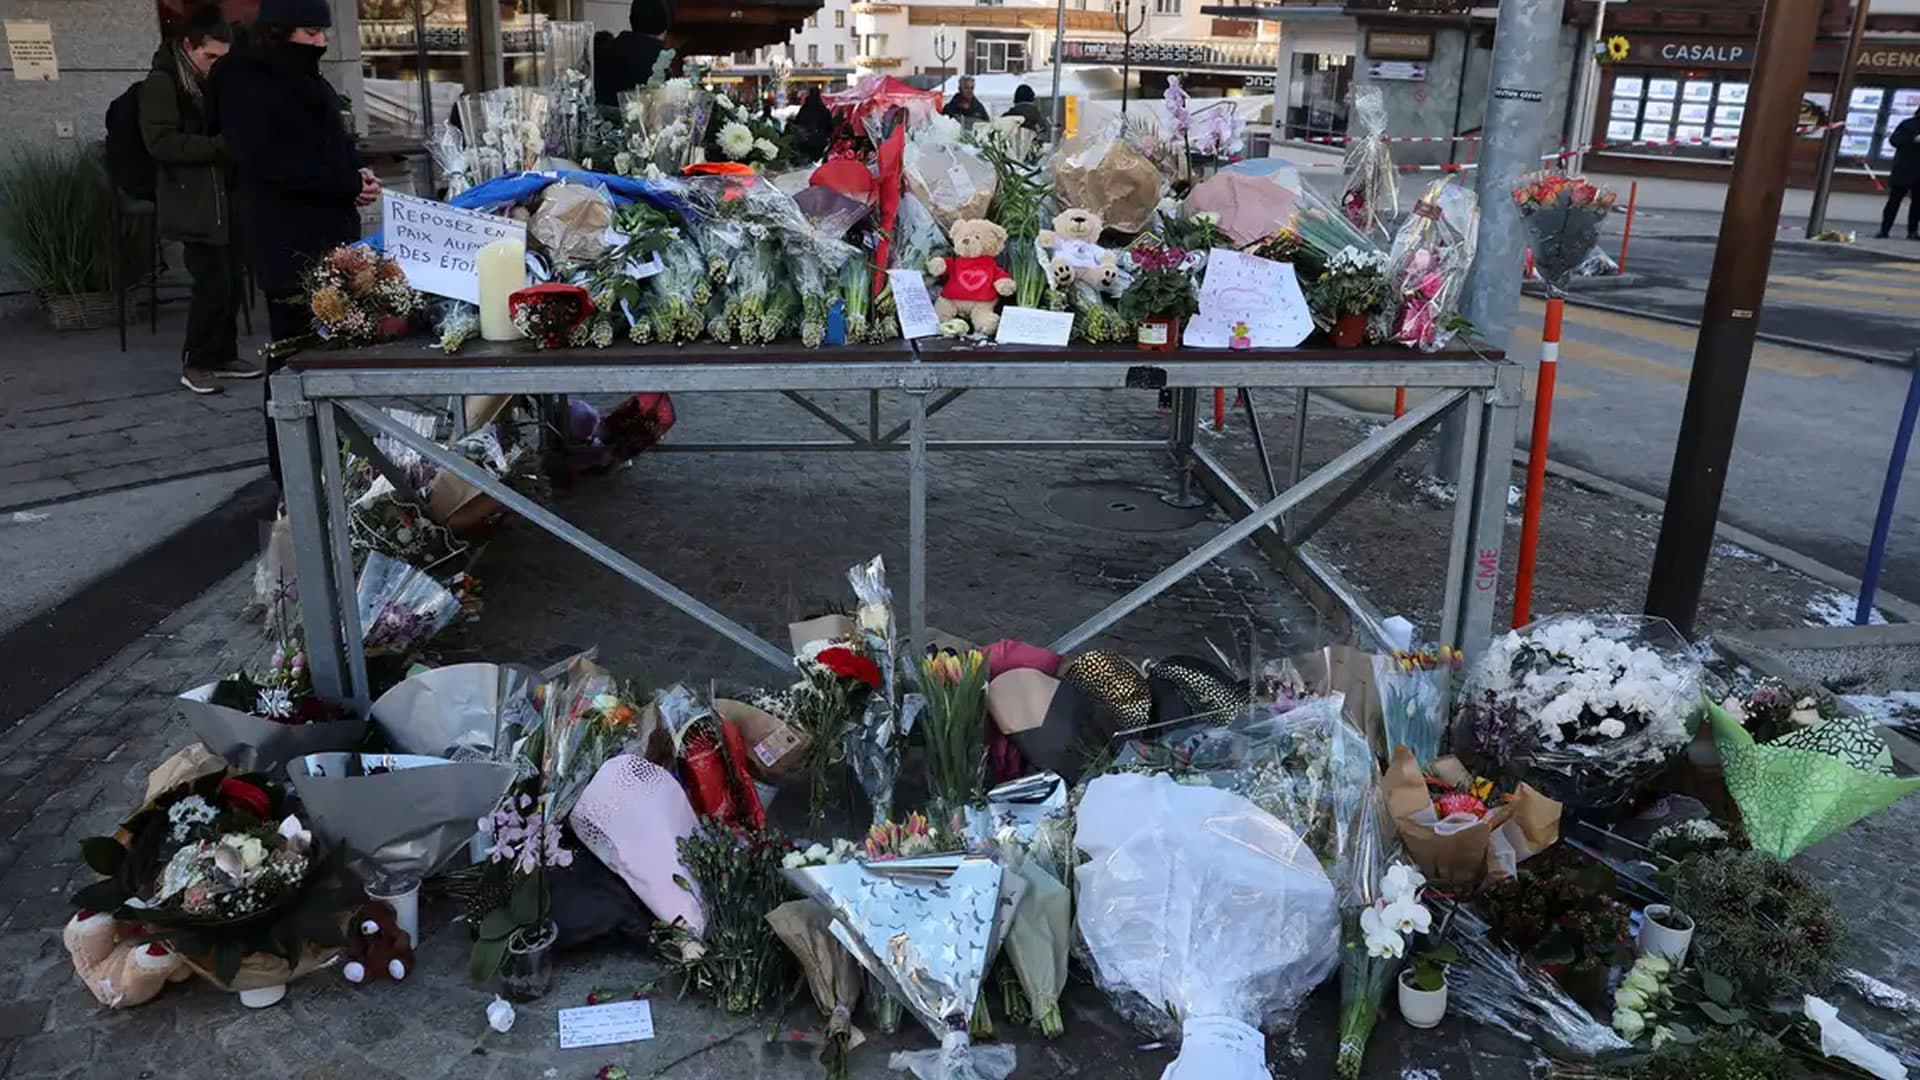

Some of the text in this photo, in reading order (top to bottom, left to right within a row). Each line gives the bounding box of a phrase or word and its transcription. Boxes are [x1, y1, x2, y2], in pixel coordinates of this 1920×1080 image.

[1662, 43, 1743, 61] CASALP
[391, 201, 506, 238] REPOSEZ EN
[397, 226, 433, 243] PAIX
[400, 243, 478, 276] DES ÉTOI
[1475, 549, 1498, 592] CME
